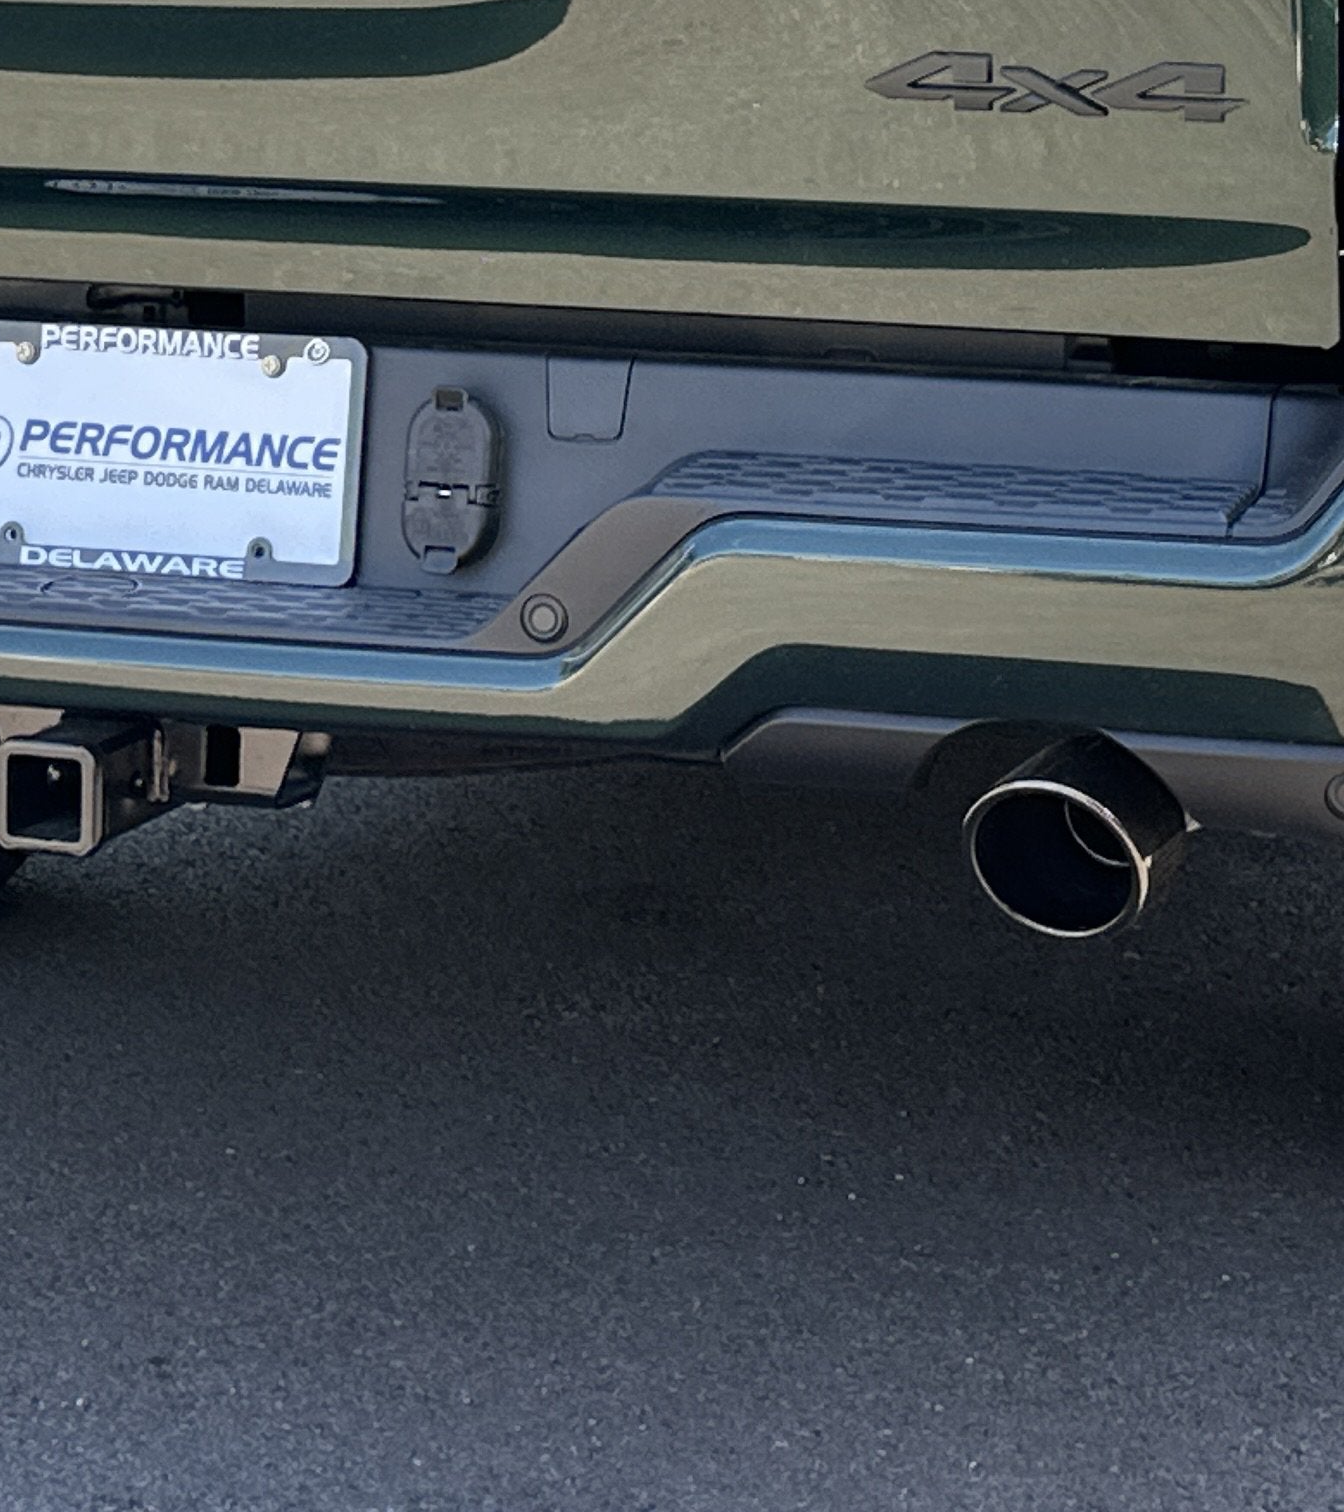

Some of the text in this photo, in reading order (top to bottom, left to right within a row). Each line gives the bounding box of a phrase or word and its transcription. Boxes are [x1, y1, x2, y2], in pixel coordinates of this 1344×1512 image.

[40, 323, 261, 361] PERFORMANCE
[19, 419, 342, 472] PERFORMANCE
[16, 461, 333, 499] CHRYSLER JEEP DODGE RAM DELAWARE
[20, 546, 246, 579] DELAWARE
